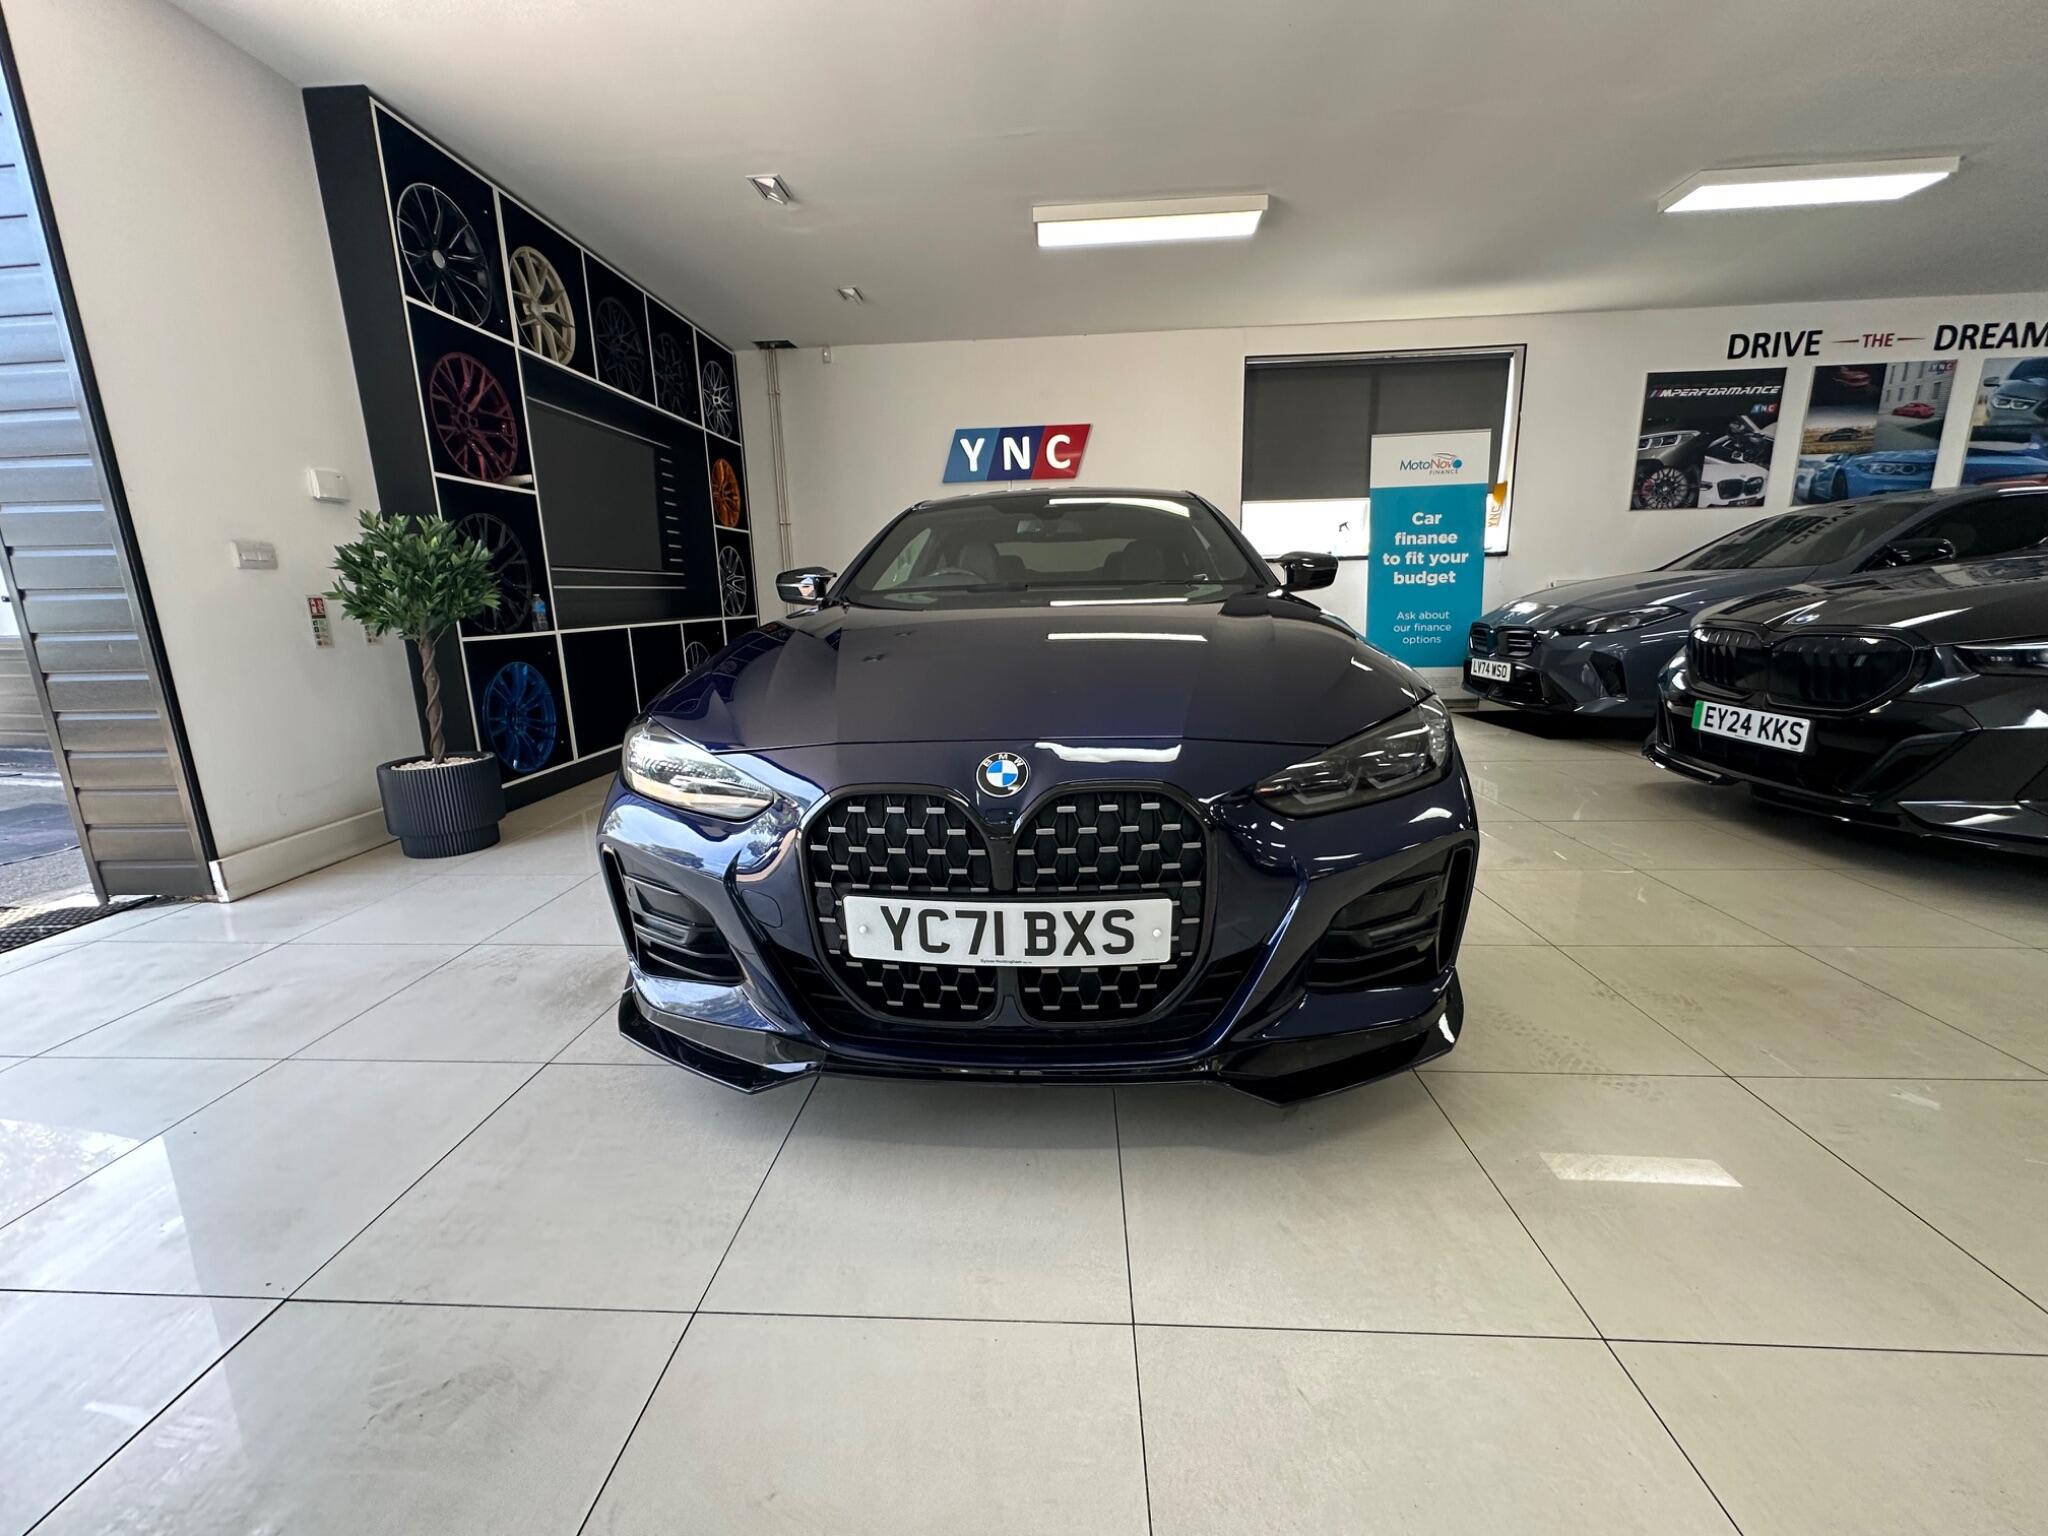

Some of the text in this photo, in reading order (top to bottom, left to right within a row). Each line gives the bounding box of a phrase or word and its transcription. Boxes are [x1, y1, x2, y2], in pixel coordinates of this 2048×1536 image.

[1727, 321, 2048, 359] DRIVE THE DREAM
[959, 434, 1071, 472] YNC
[1411, 511, 1443, 526] Car
[1394, 531, 1458, 546] finance
[1382, 551, 1470, 567] to fit your
[1393, 570, 1457, 586] budget
[1396, 610, 1451, 621] Ask about
[1393, 622, 1452, 633] our finance
[1402, 635, 1442, 646] options
[1473, 660, 1490, 675] LV74
[1703, 705, 1805, 746] EY24 KKS
[981, 753, 1025, 768] BMW
[879, 905, 1136, 958] YC71 BXS
